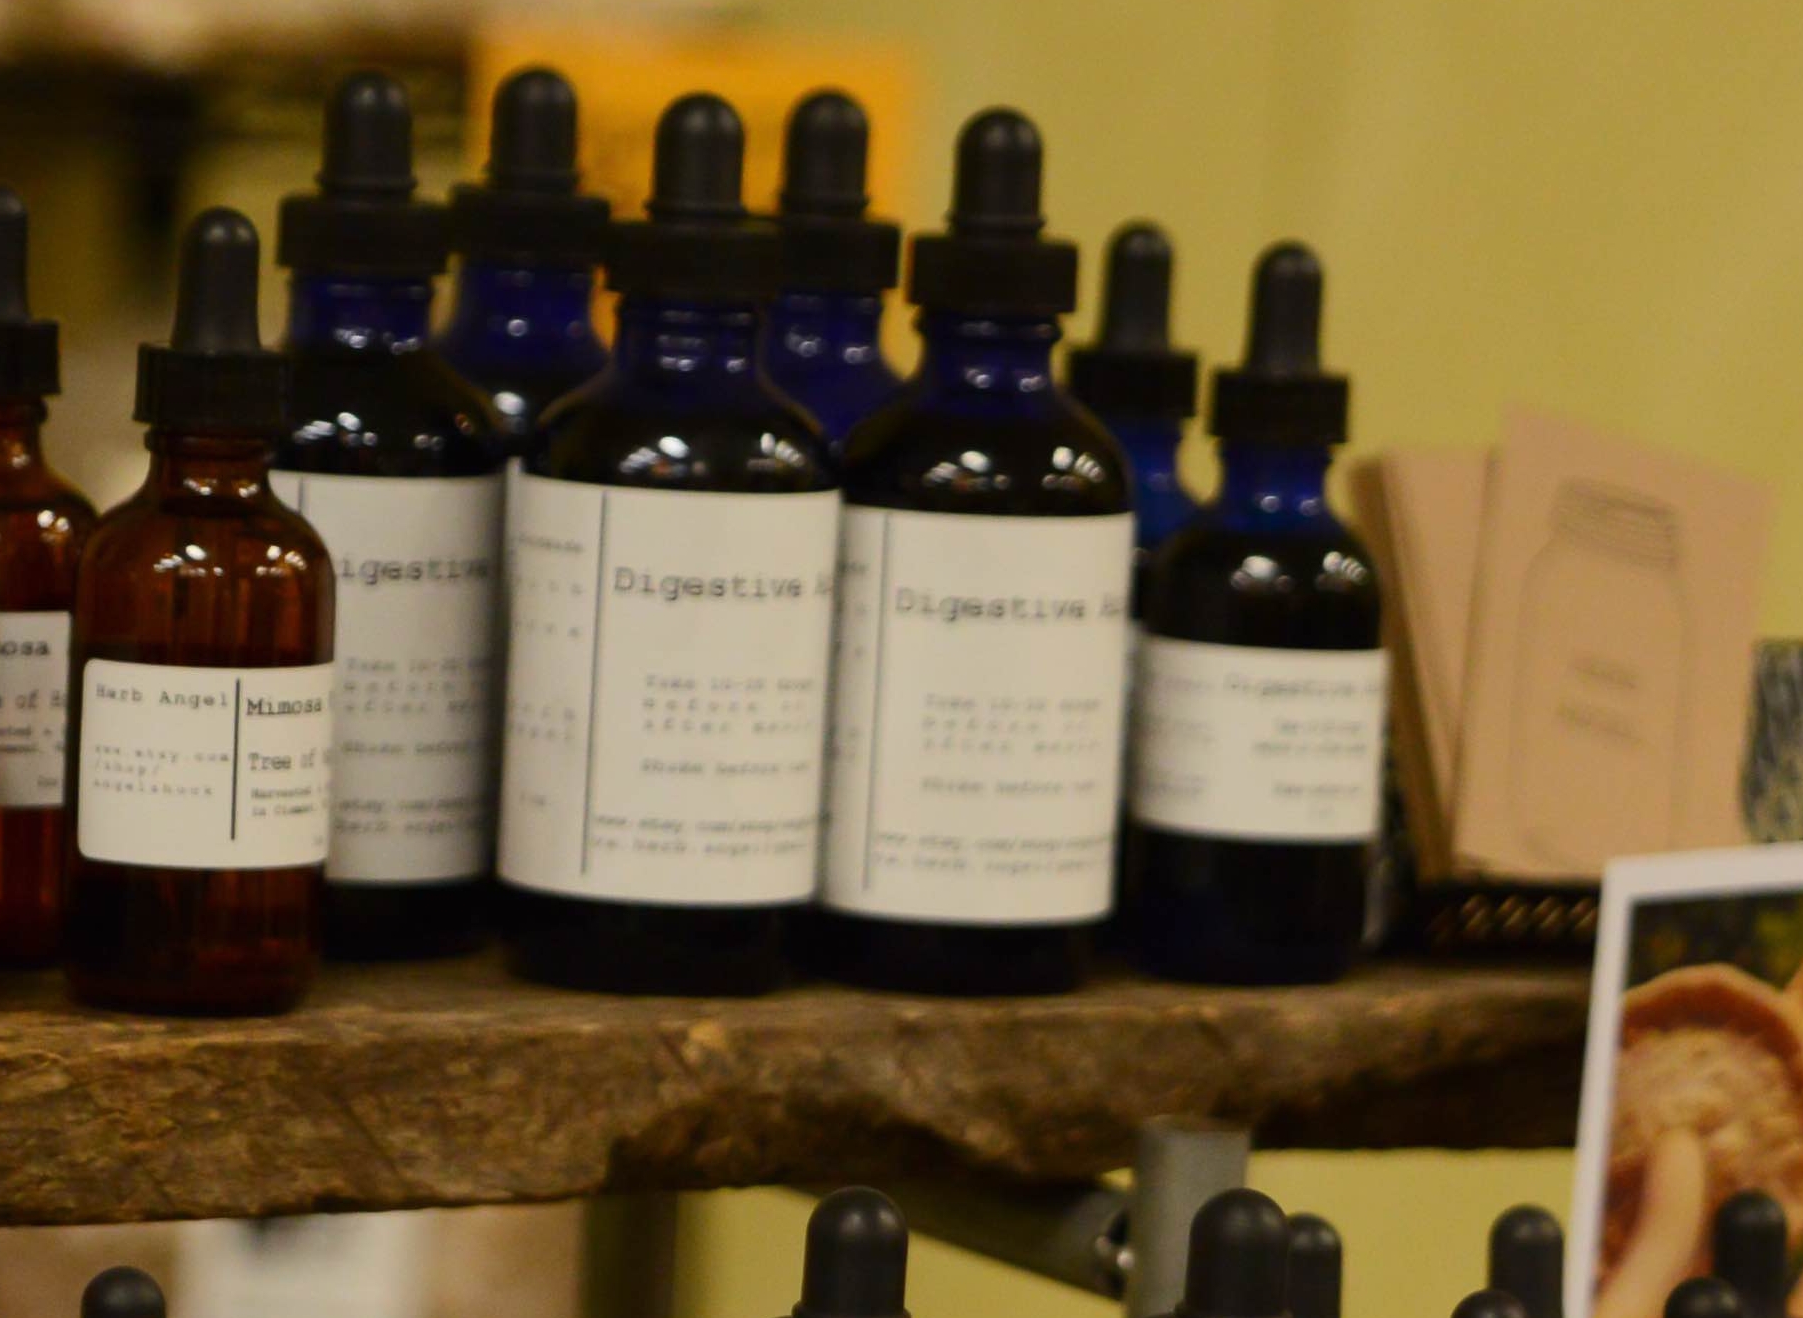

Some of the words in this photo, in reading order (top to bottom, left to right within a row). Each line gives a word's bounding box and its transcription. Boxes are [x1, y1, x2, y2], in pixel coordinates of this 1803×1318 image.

[612, 566, 802, 602] Digestive
[159, 690, 229, 712] Angel
[247, 696, 323, 717] Mimosa
[248, 752, 293, 771] Tree
